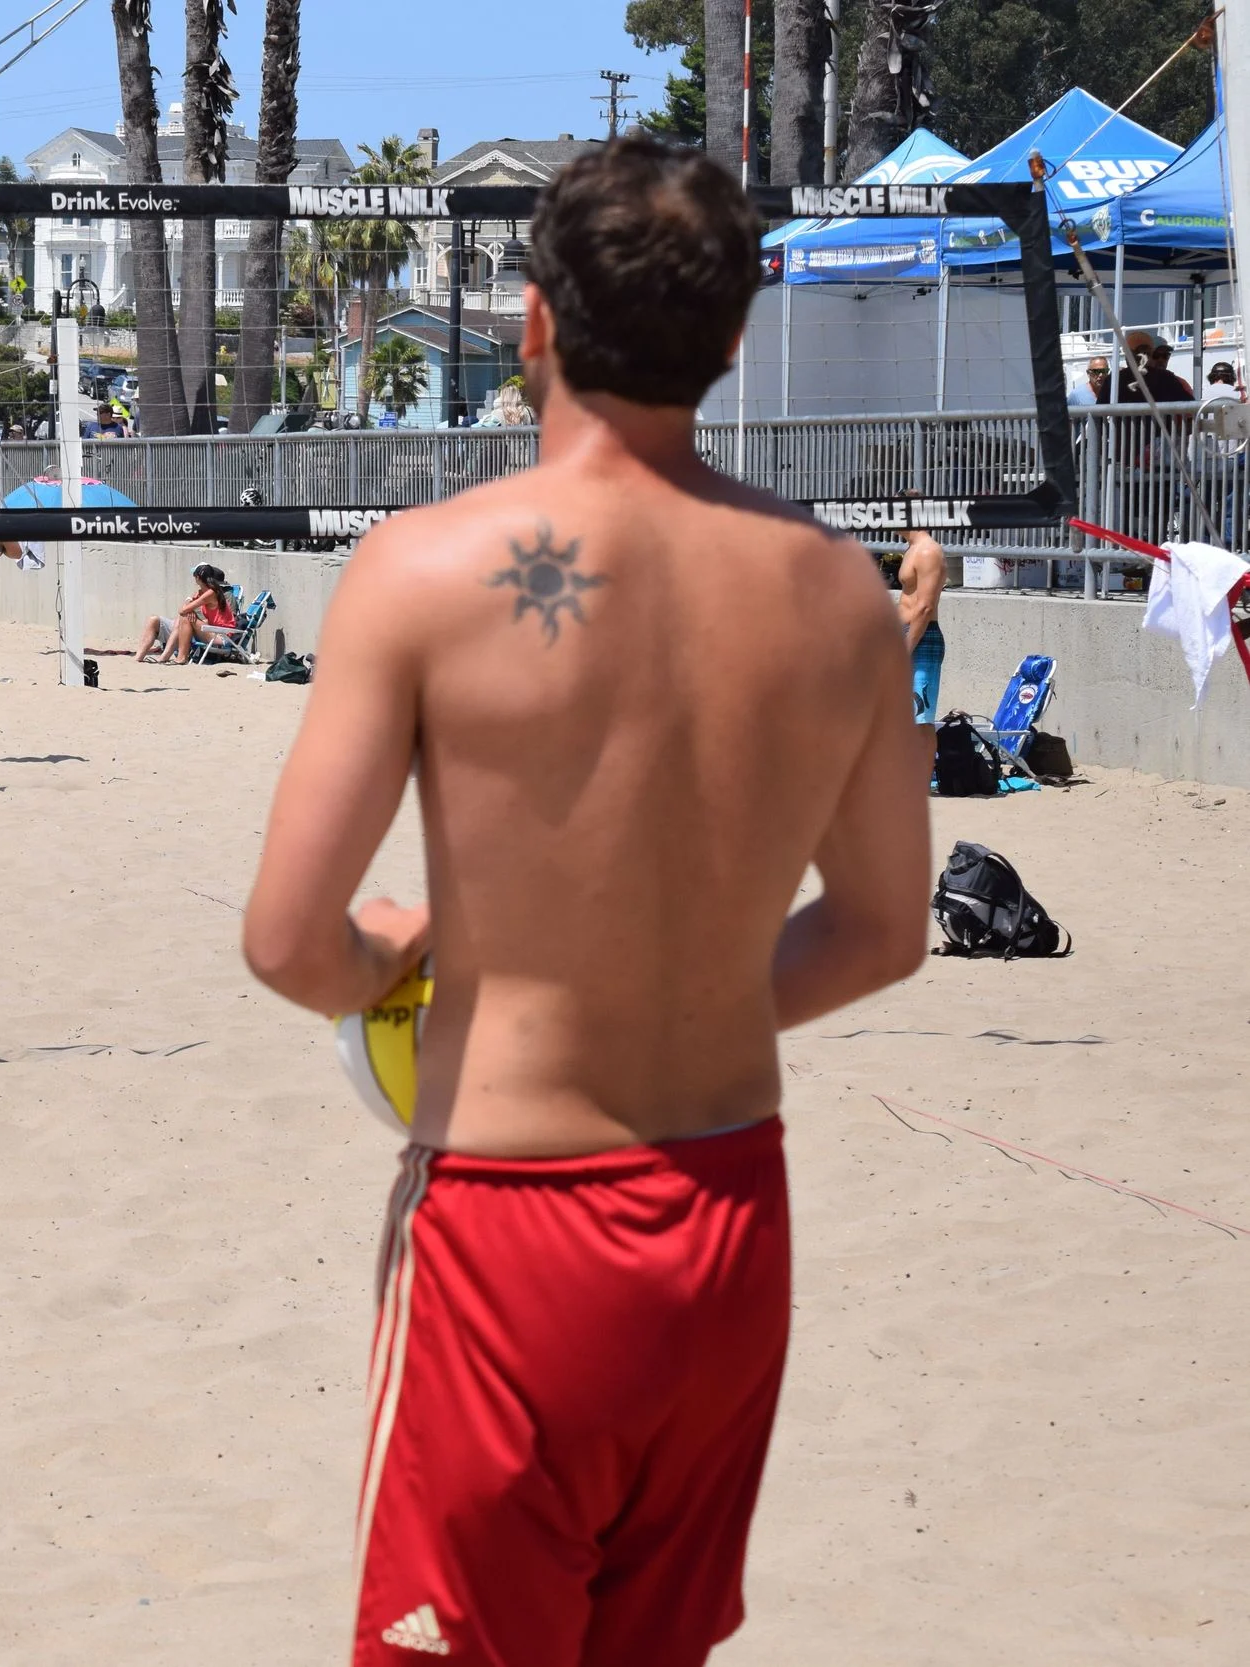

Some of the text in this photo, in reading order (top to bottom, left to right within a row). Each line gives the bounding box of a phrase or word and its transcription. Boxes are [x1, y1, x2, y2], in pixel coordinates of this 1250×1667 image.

[1067, 160, 1169, 180] BUD
[1058, 179, 1146, 199] LIG
[52, 190, 115, 211] Drink.
[289, 187, 450, 216] MUSCLE MILK
[792, 185, 949, 216] MUSCLE MILK
[1140, 209, 1229, 228] CALIFORNIA
[71, 515, 135, 535] Drink.
[309, 510, 405, 537] MUSC
[813, 500, 972, 529] MUSCLE MILK
